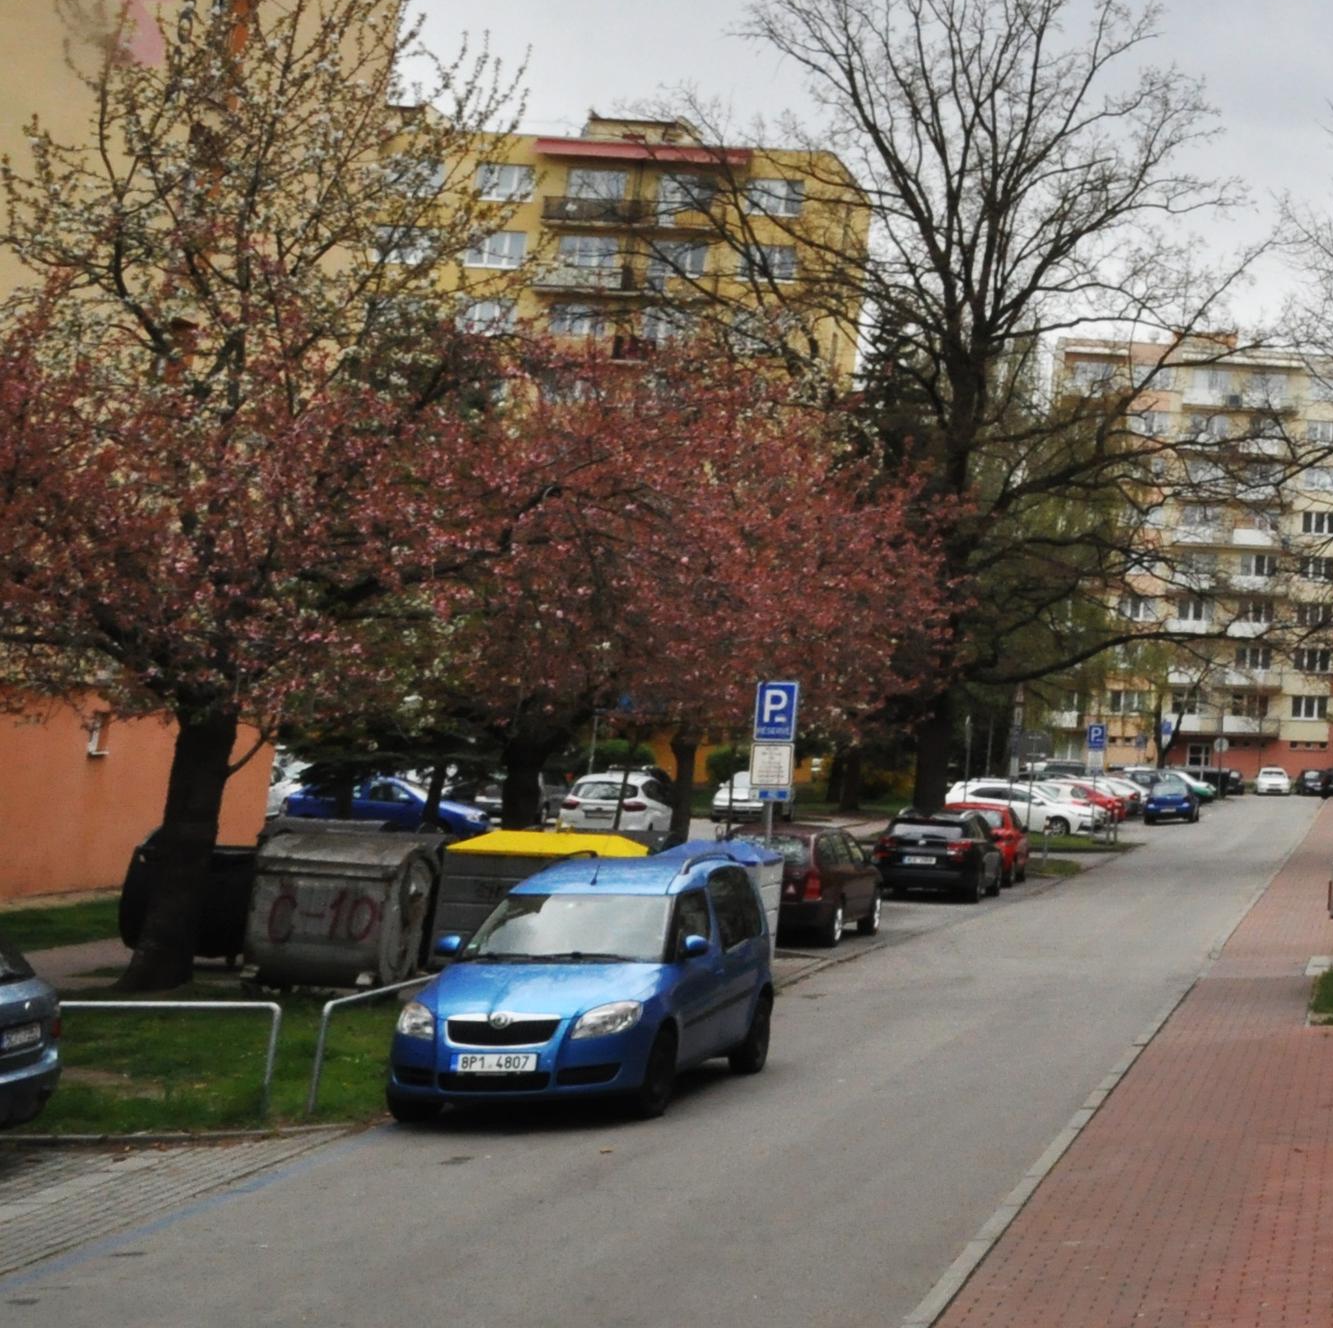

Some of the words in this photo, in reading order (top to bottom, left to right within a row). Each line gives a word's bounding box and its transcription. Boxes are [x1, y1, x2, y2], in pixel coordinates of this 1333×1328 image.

[763, 689, 788, 723] P
[461, 1056, 485, 1069] 8P1
[495, 1055, 529, 1069] 4807
